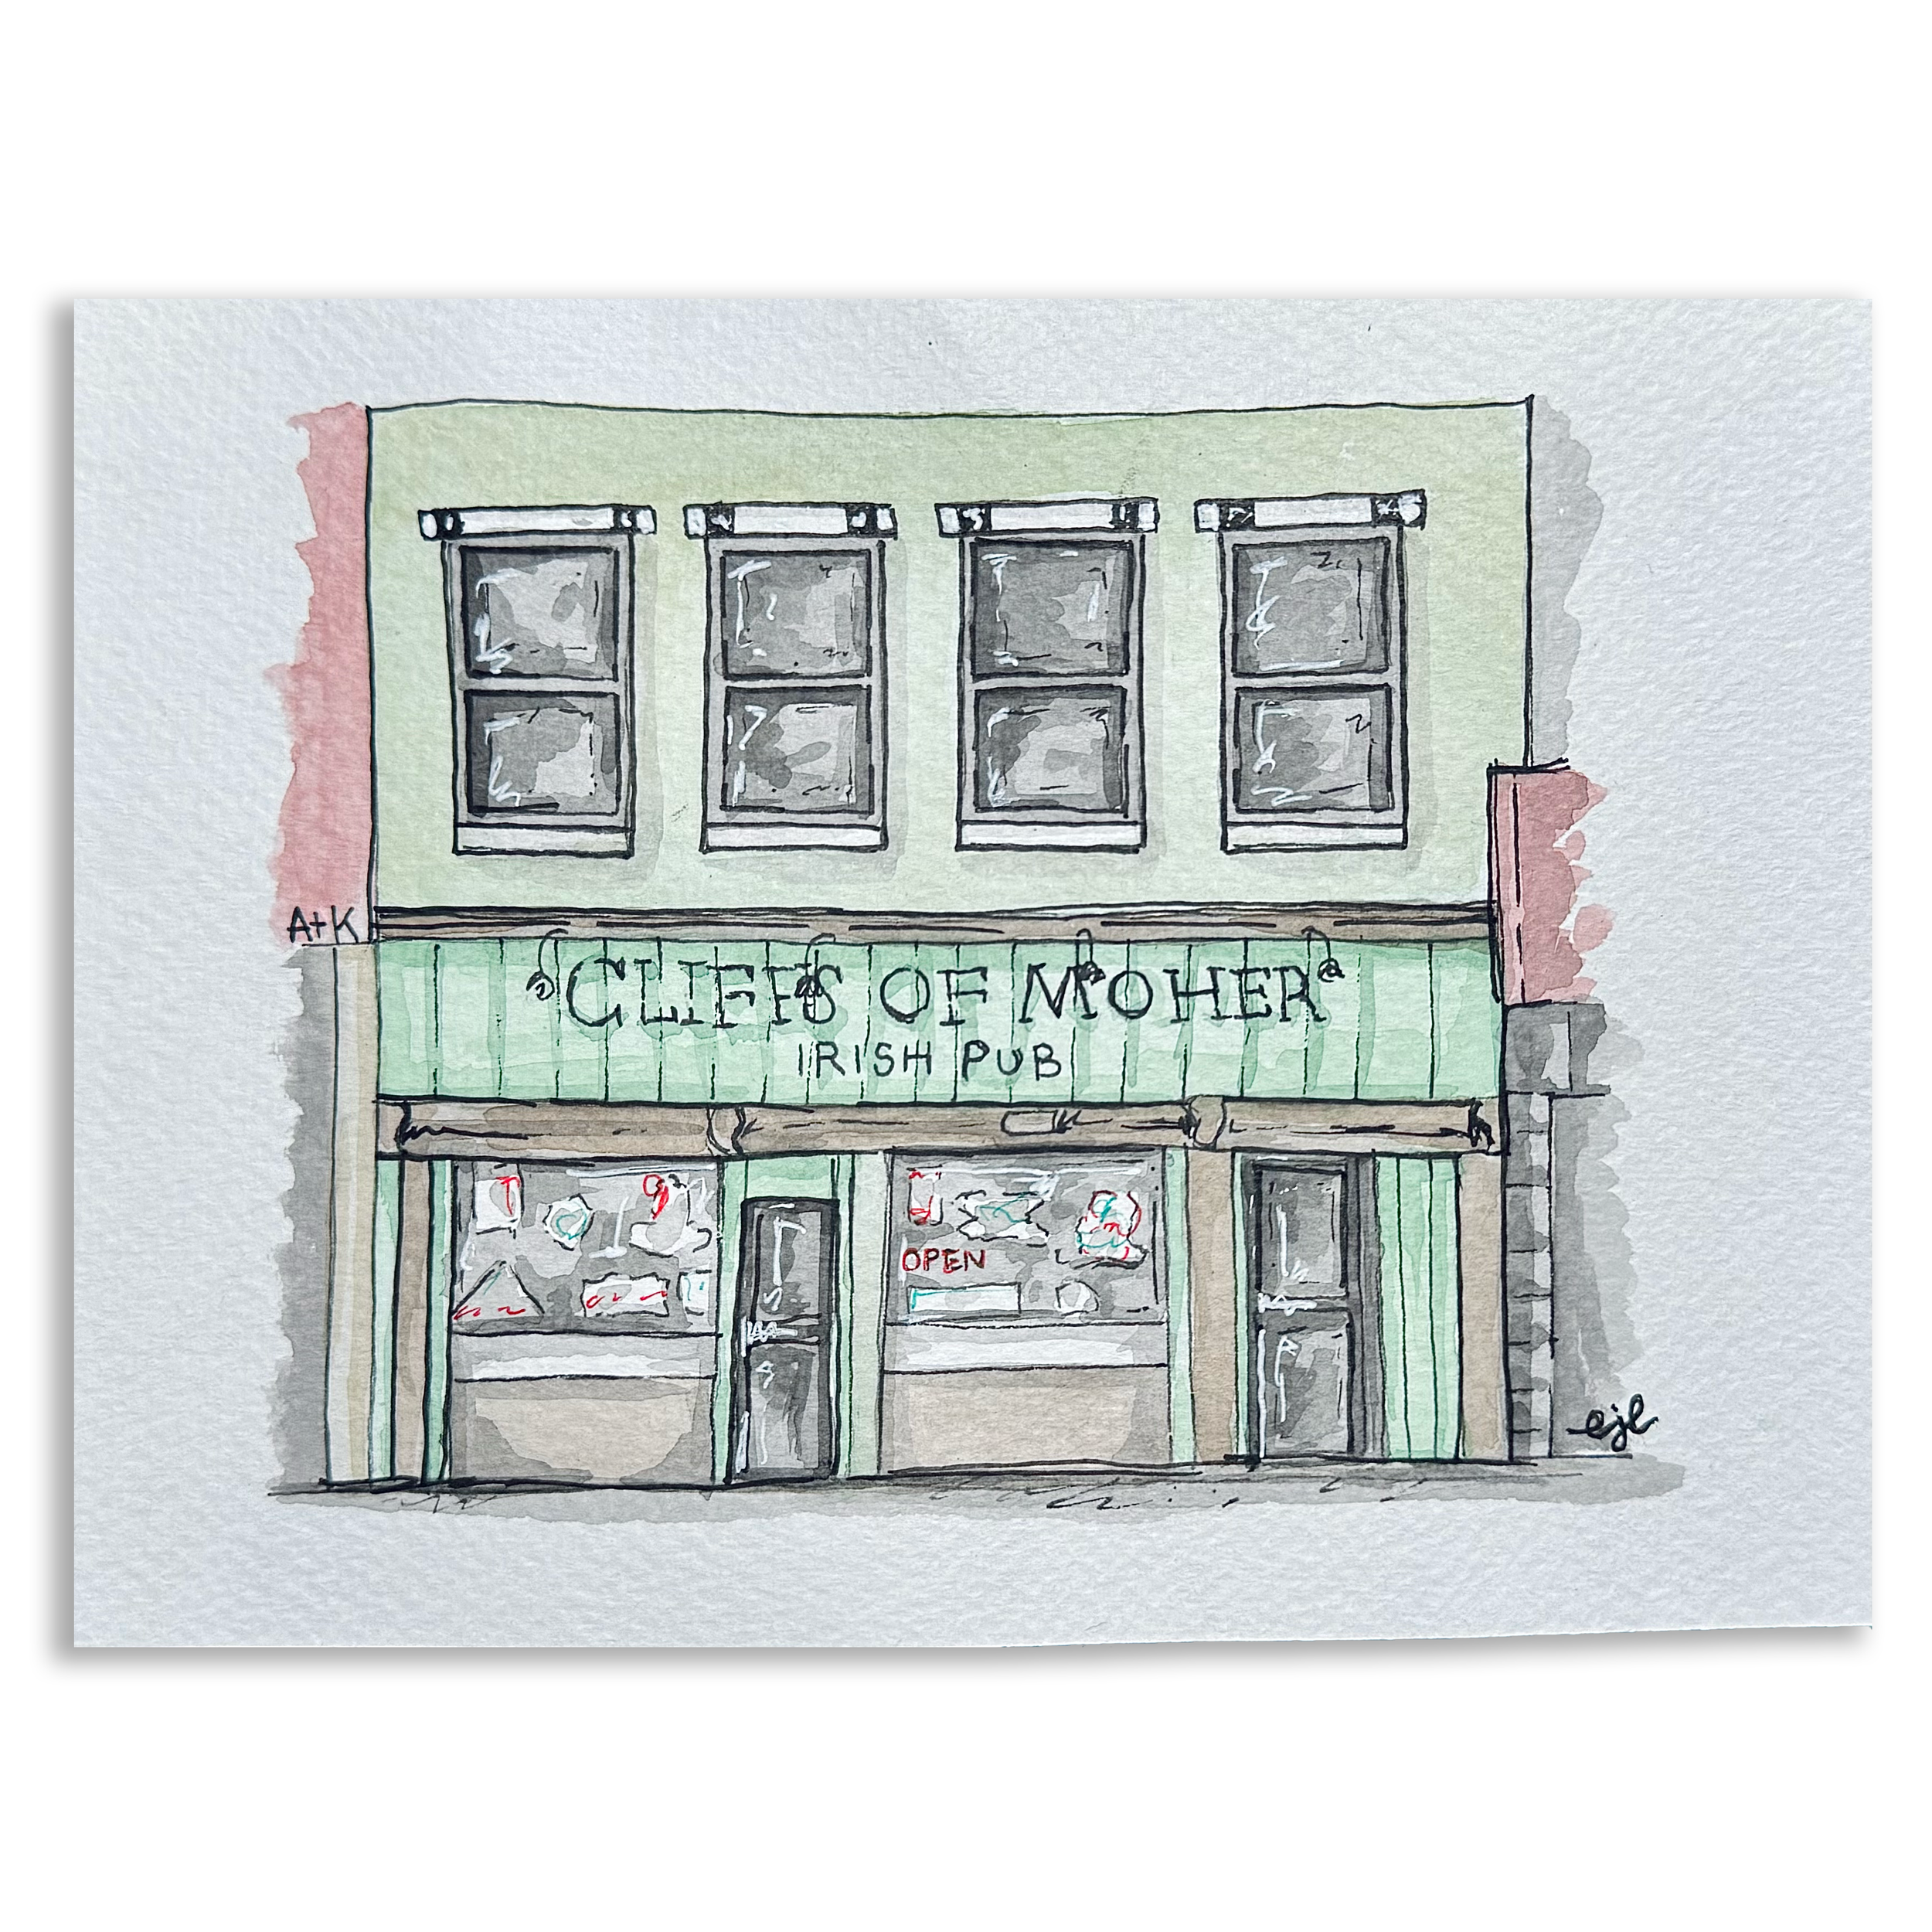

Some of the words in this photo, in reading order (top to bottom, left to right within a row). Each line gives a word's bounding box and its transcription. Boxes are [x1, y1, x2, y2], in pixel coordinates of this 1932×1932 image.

[566, 957, 843, 1029] CLIFFS
[879, 965, 988, 1026] OF
[1019, 963, 1328, 1023] MOHER
[798, 1040, 933, 1079] IRISH
[961, 1039, 1062, 1081] PUB
[902, 1247, 986, 1274] OPEN
